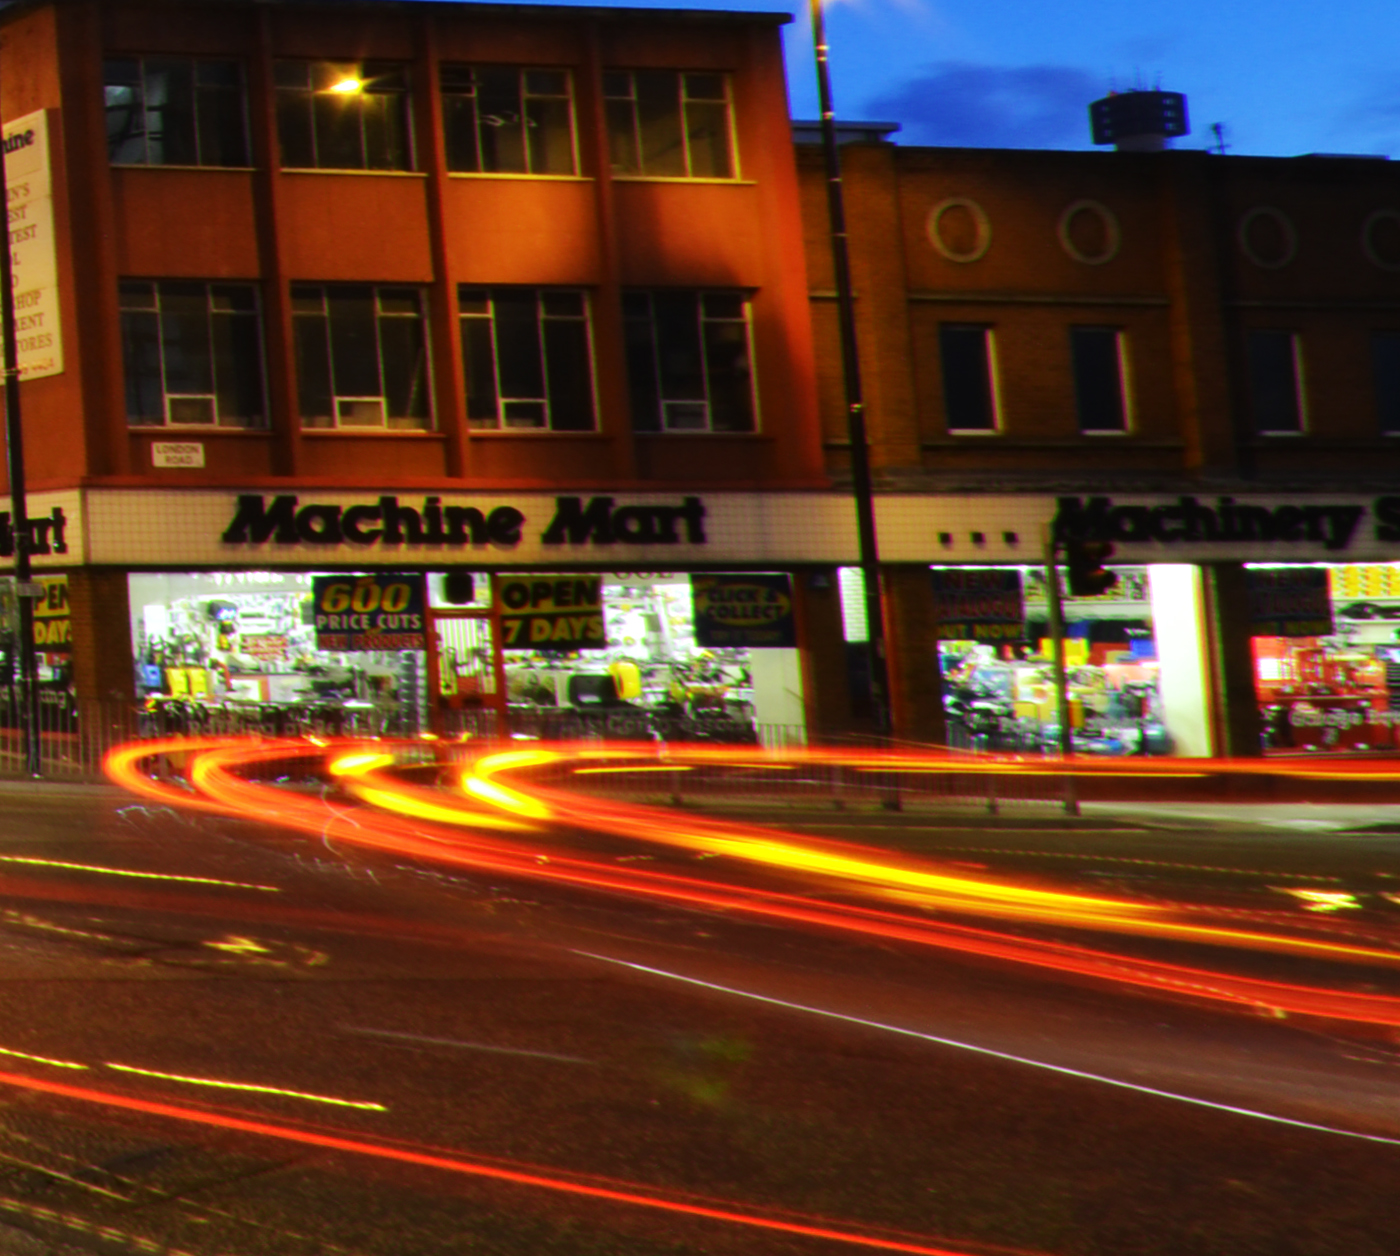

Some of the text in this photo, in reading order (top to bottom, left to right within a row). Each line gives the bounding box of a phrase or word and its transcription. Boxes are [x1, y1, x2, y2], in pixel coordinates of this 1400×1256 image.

[155, 444, 200, 454] LONDON
[164, 455, 194, 464] ROAD
[222, 495, 707, 545] Machine Mart
[1053, 496, 1367, 551] Machinery
[319, 583, 411, 613] 600
[502, 580, 598, 610] OPEN
[316, 613, 422, 630] PRICE CUTS
[705, 604, 785, 620] COLLECT
[503, 616, 603, 644] 7 DAYS
